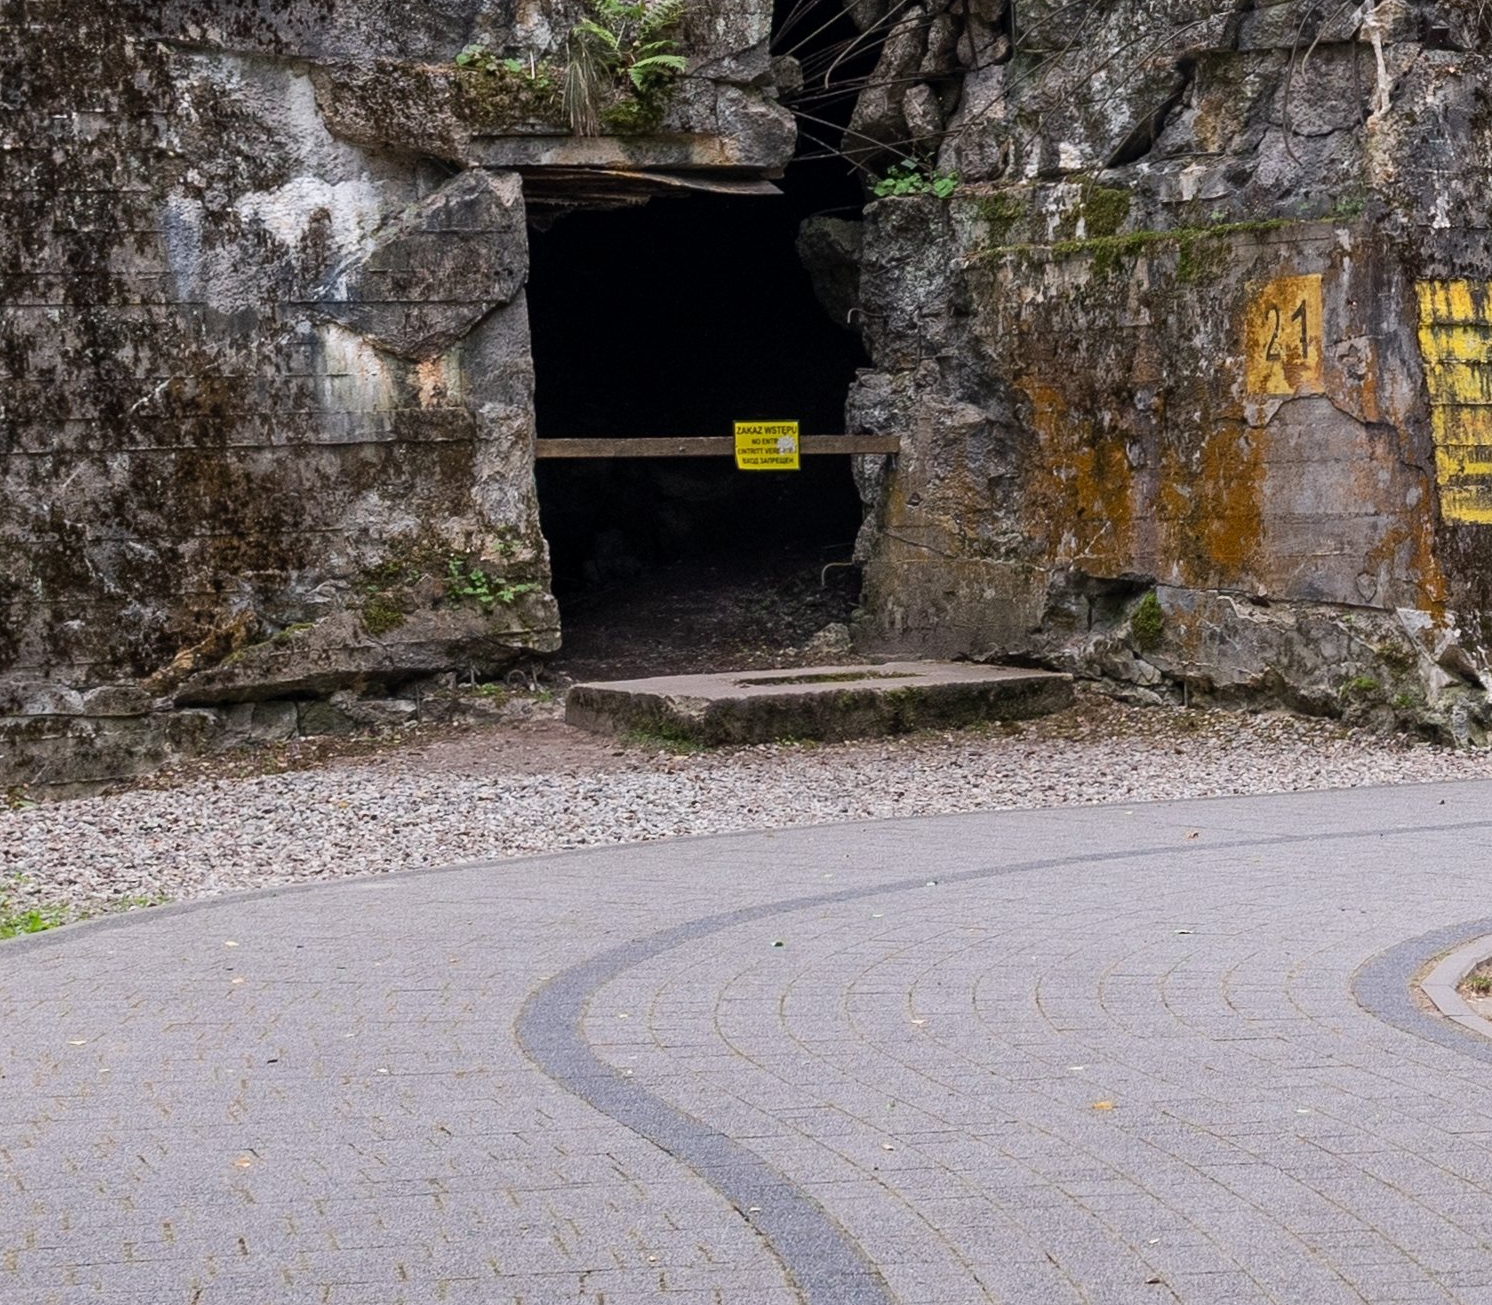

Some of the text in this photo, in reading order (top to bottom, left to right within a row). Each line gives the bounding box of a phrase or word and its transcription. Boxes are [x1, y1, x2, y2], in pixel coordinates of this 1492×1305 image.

[1265, 299, 1308, 362] 21
[736, 426, 797, 435] ZAKAZ WSTĘPU
